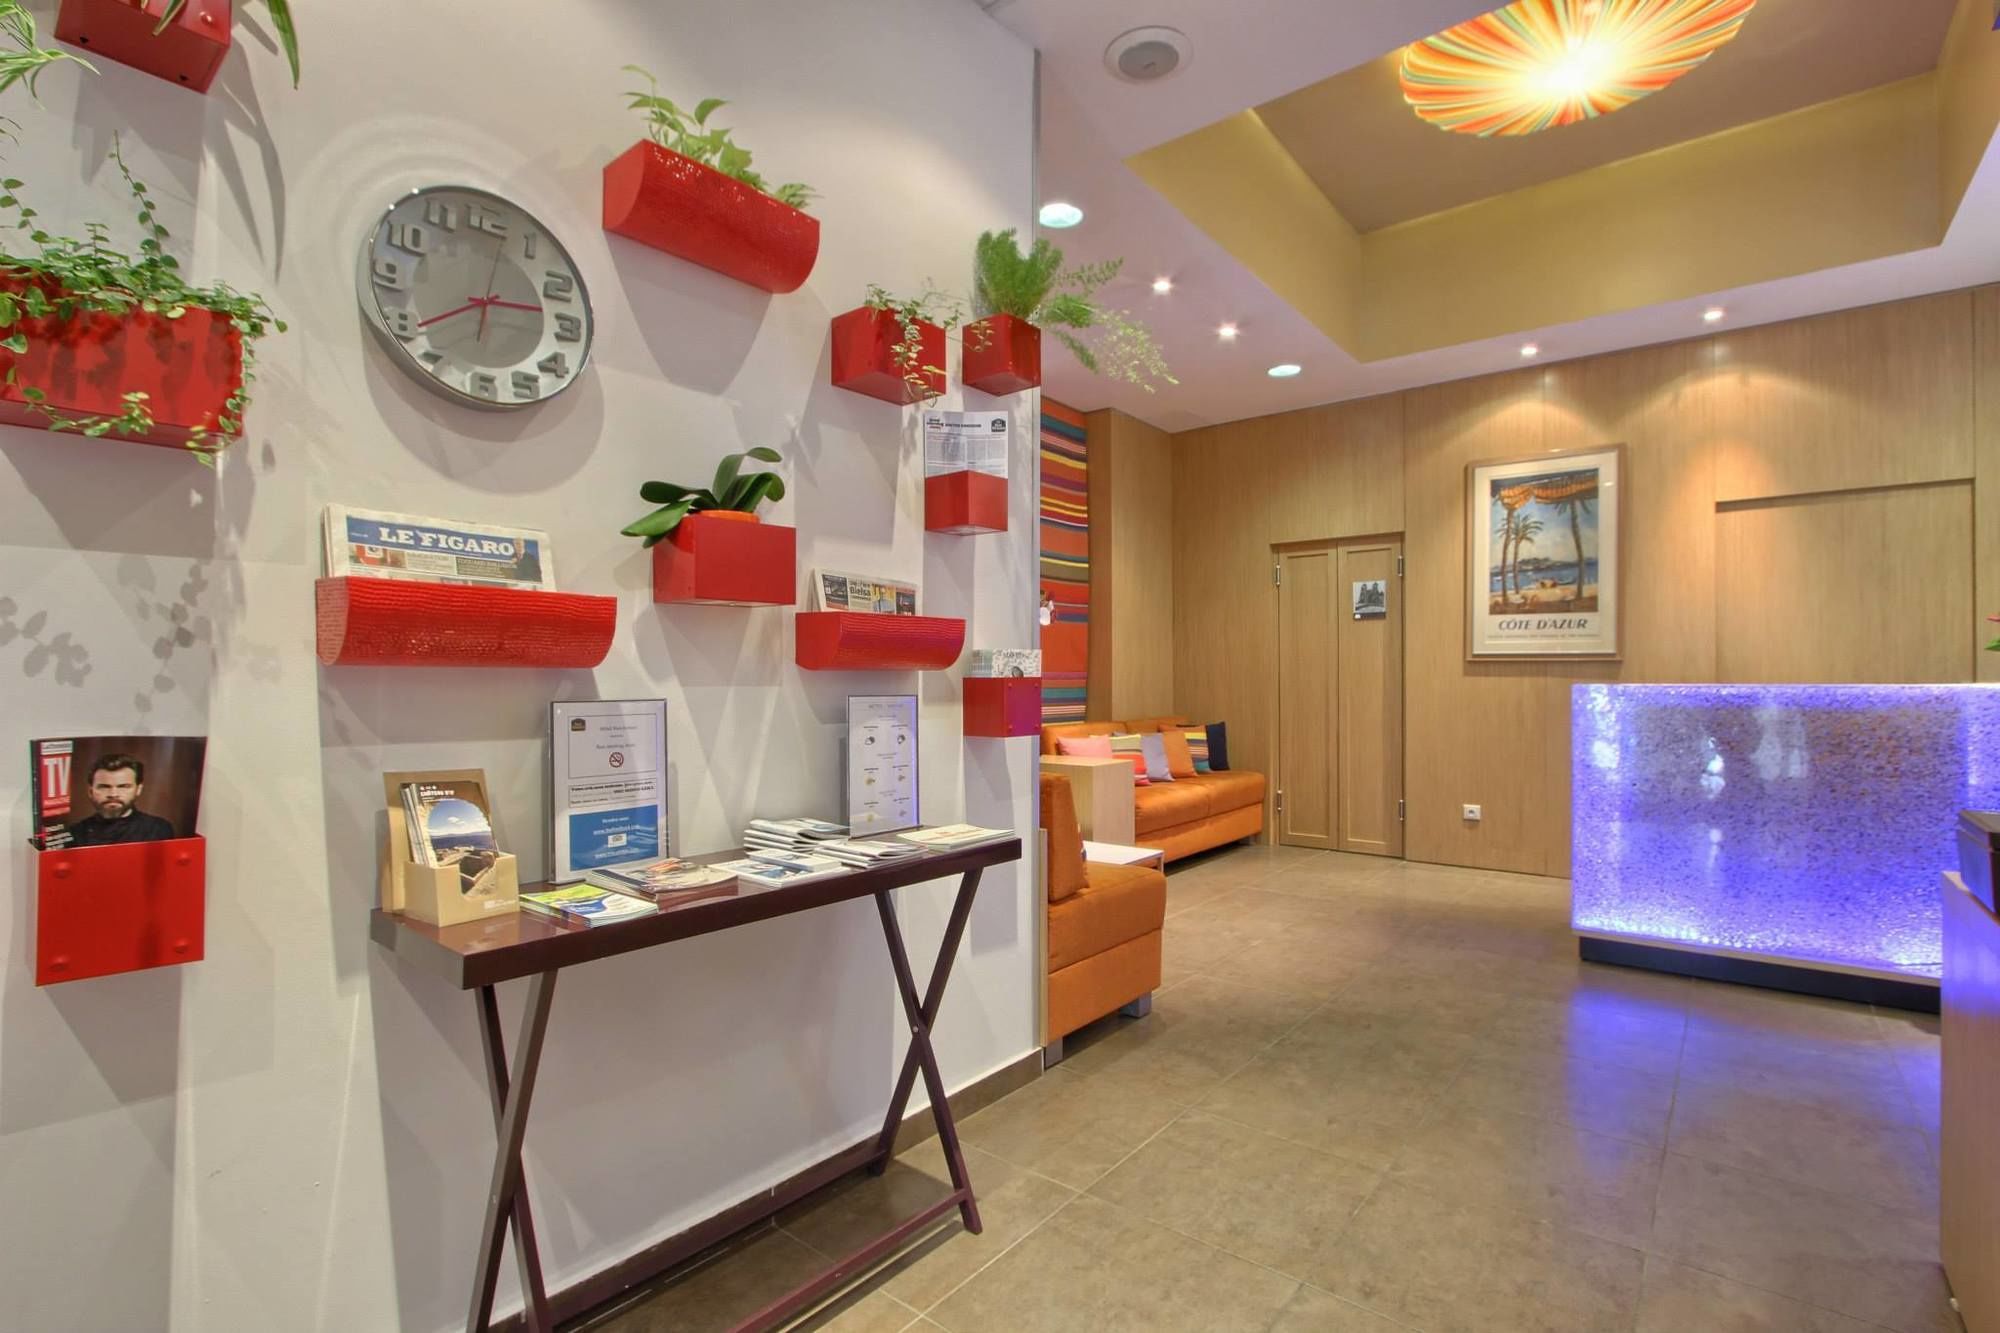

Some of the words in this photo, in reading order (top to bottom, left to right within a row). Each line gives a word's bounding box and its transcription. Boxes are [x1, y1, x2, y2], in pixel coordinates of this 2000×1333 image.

[424, 199, 457, 232] 11
[464, 203, 508, 241] 12
[387, 221, 426, 255] 10
[524, 232, 537, 259] 1
[373, 259, 404, 291] 9
[543, 270, 574, 303] 2
[385, 310, 418, 341] 8
[554, 313, 582, 342] 3
[538, 352, 570, 378] 4
[469, 372, 498, 401] 6
[512, 371, 540, 399] 5
[378, 527, 414, 545] LE
[418, 531, 514, 556] FIGARO
[44, 756, 71, 798] TV
